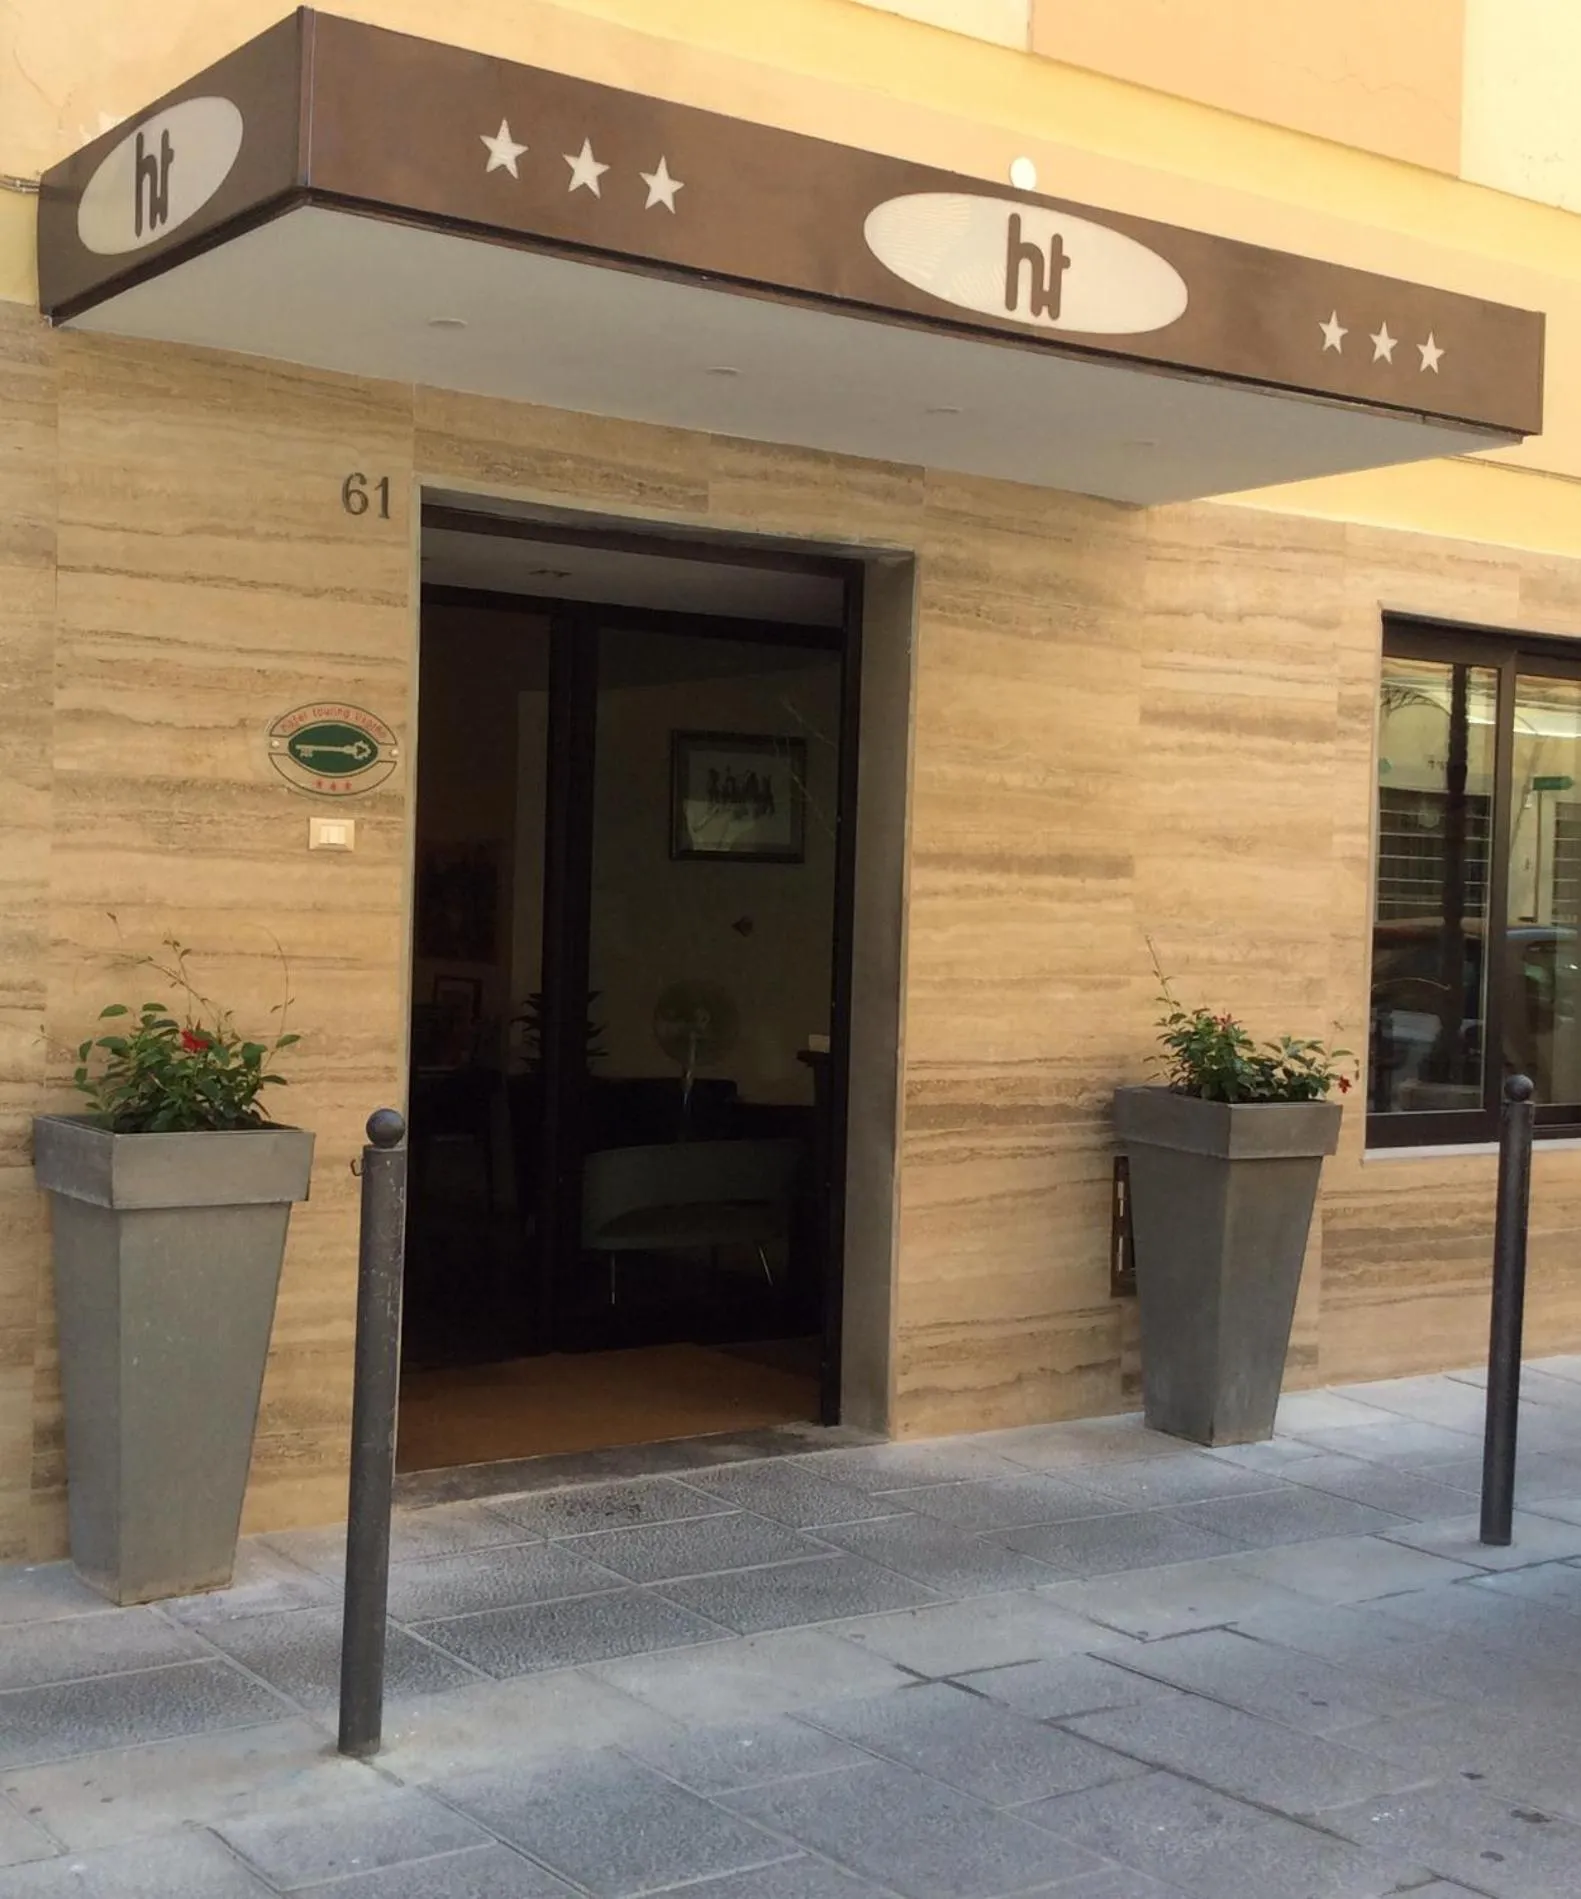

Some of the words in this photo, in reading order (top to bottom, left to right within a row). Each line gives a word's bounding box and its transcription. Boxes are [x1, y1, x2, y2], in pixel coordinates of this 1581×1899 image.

[135, 128, 175, 239] ht
[1005, 212, 1071, 321] ht
[341, 471, 391, 520] 61
